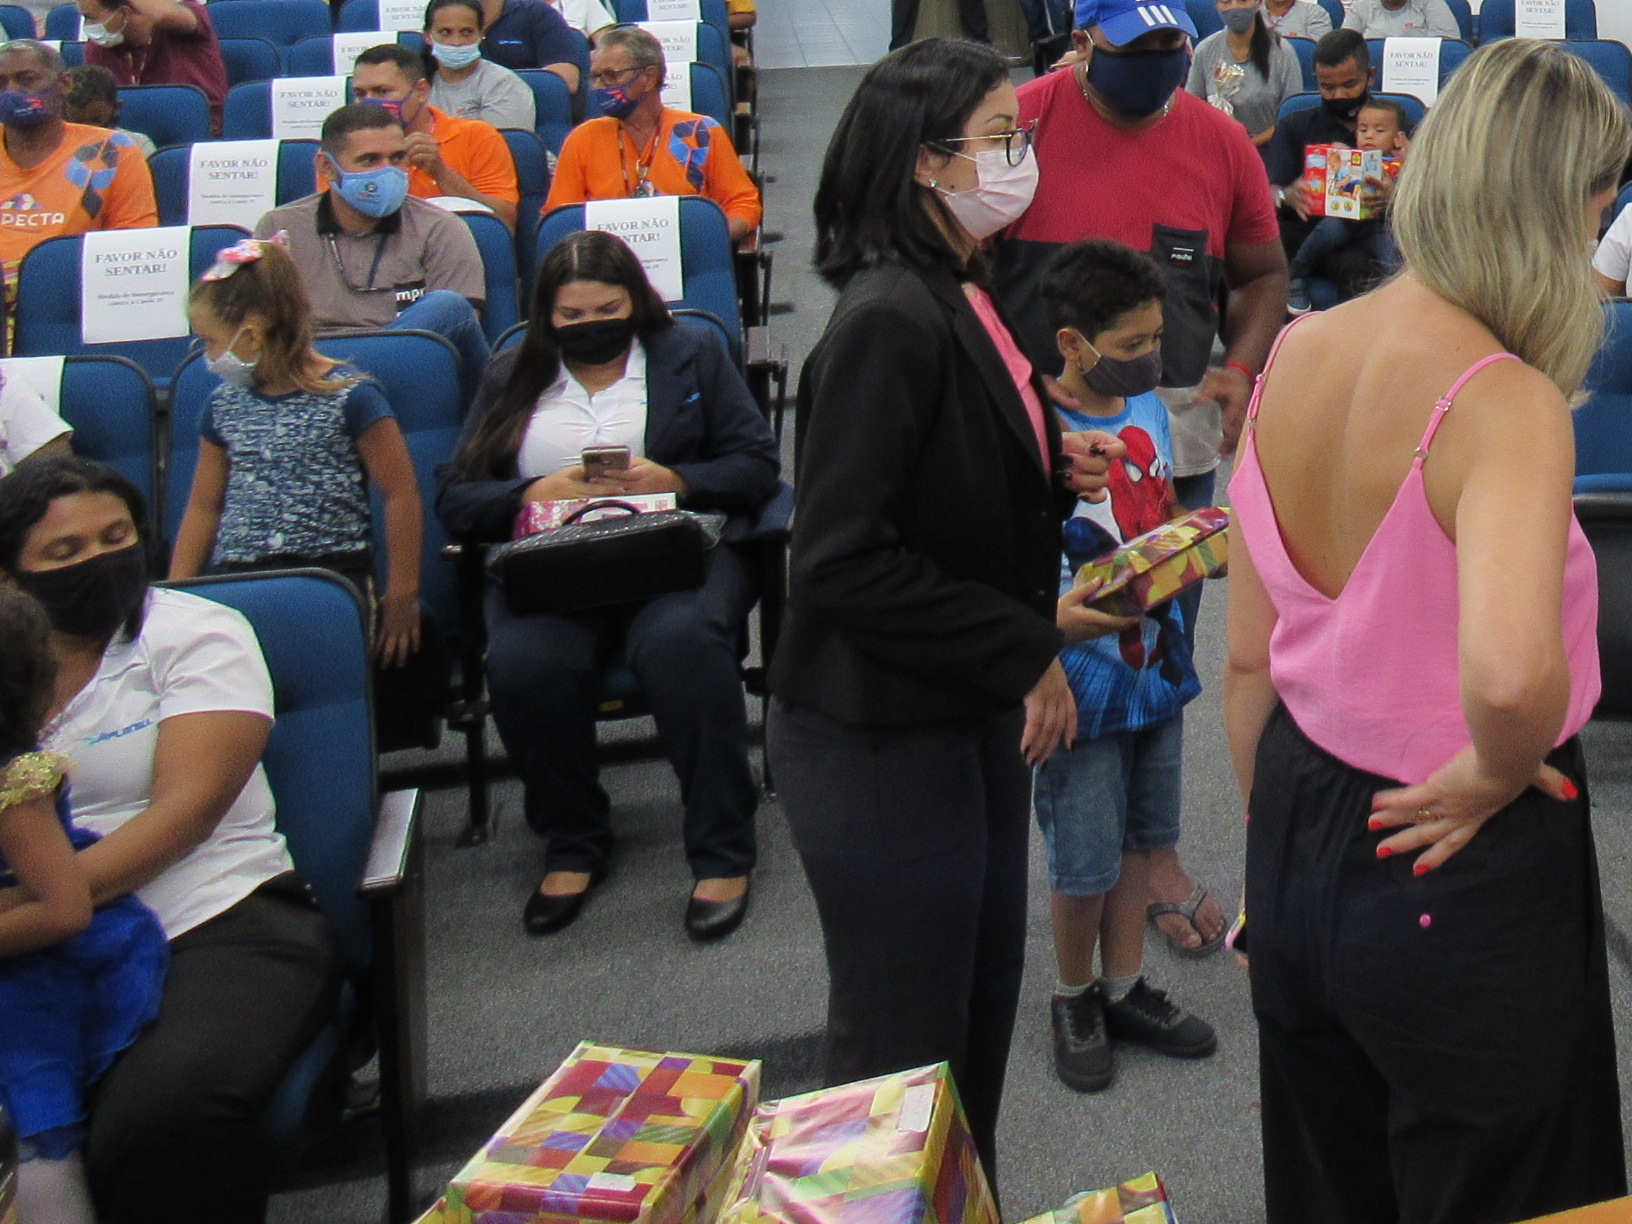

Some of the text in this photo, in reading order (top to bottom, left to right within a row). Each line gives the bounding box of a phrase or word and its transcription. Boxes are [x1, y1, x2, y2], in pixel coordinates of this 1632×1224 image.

[1416, 51, 1433, 59] NÃO
[280, 89, 338, 99] FAVOR NÃO
[287, 100, 330, 109] SENTAR!
[200, 157, 268, 169] FAVOR NÃO
[208, 170, 258, 181] SENTAR!
[641, 217, 669, 228] NÃO
[95, 248, 178, 264] FAVOR NÃO
[105, 263, 167, 276] SENTAR!
